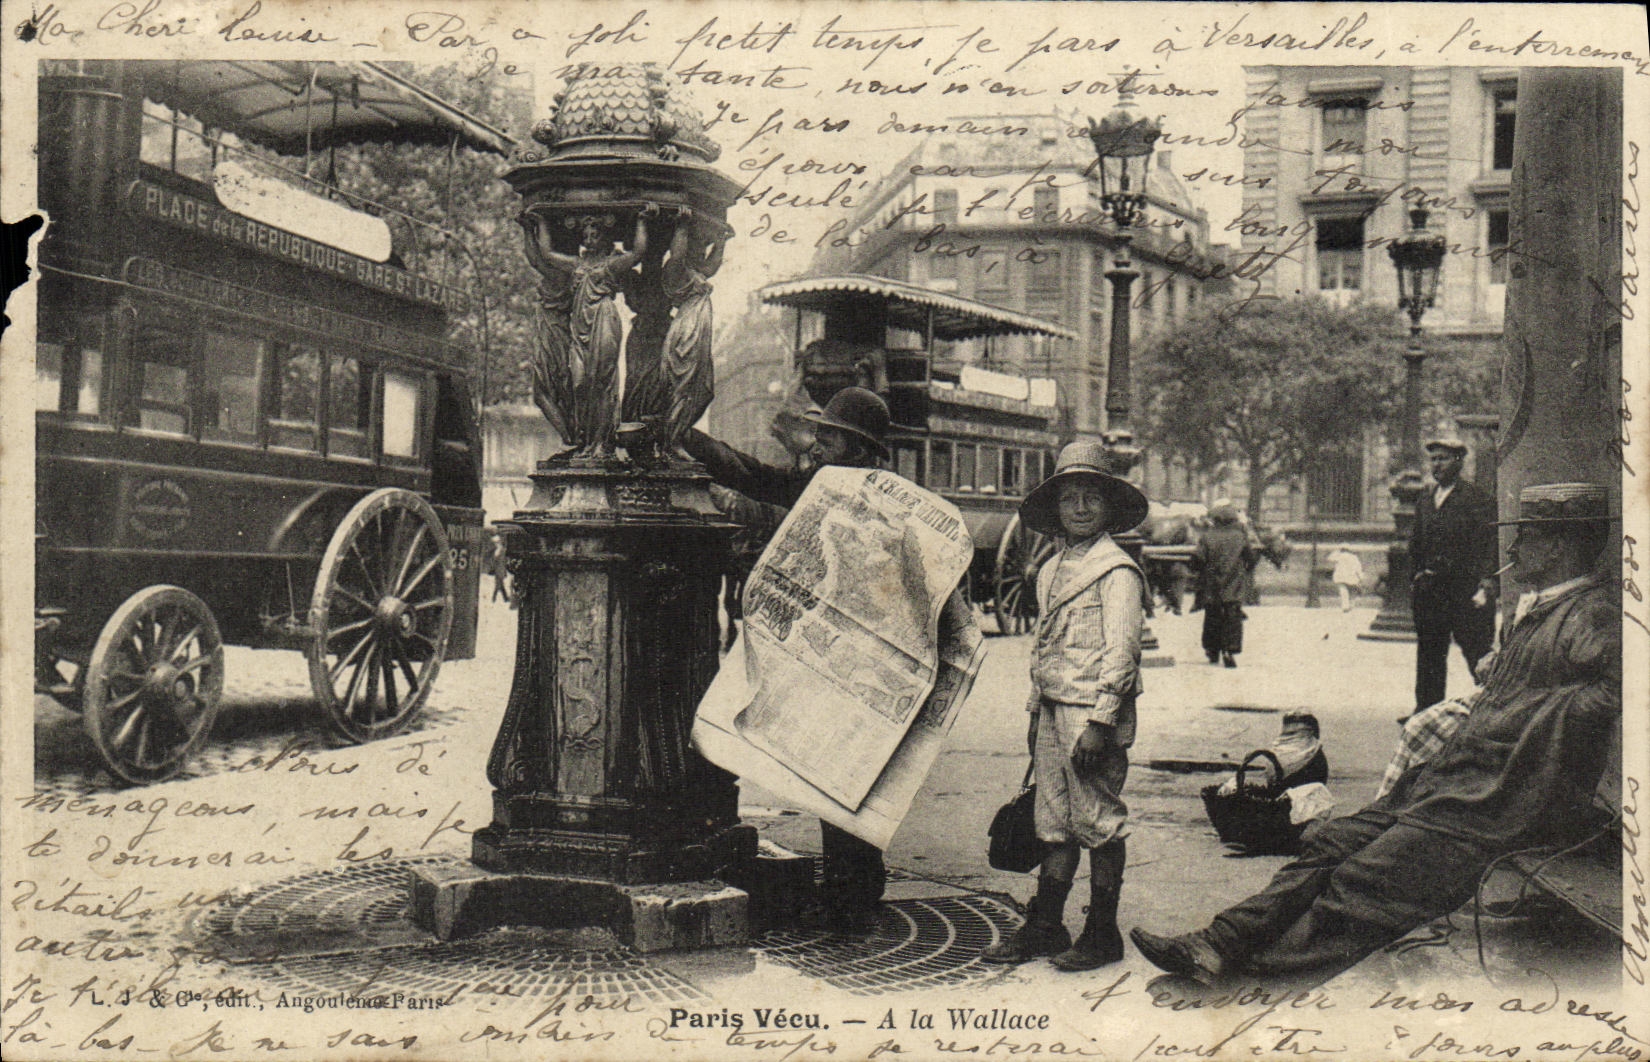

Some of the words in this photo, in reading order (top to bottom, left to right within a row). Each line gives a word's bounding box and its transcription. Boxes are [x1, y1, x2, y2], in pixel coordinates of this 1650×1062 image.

[567, 9, 650, 58] joli
[676, 16, 797, 70] petit
[836, 77, 929, 97] nous
[737, 108, 849, 152] pars
[877, 112, 1028, 136] demain
[146, 187, 208, 231] PLACE
[750, 213, 798, 243] de
[300, 791, 428, 821] mais
